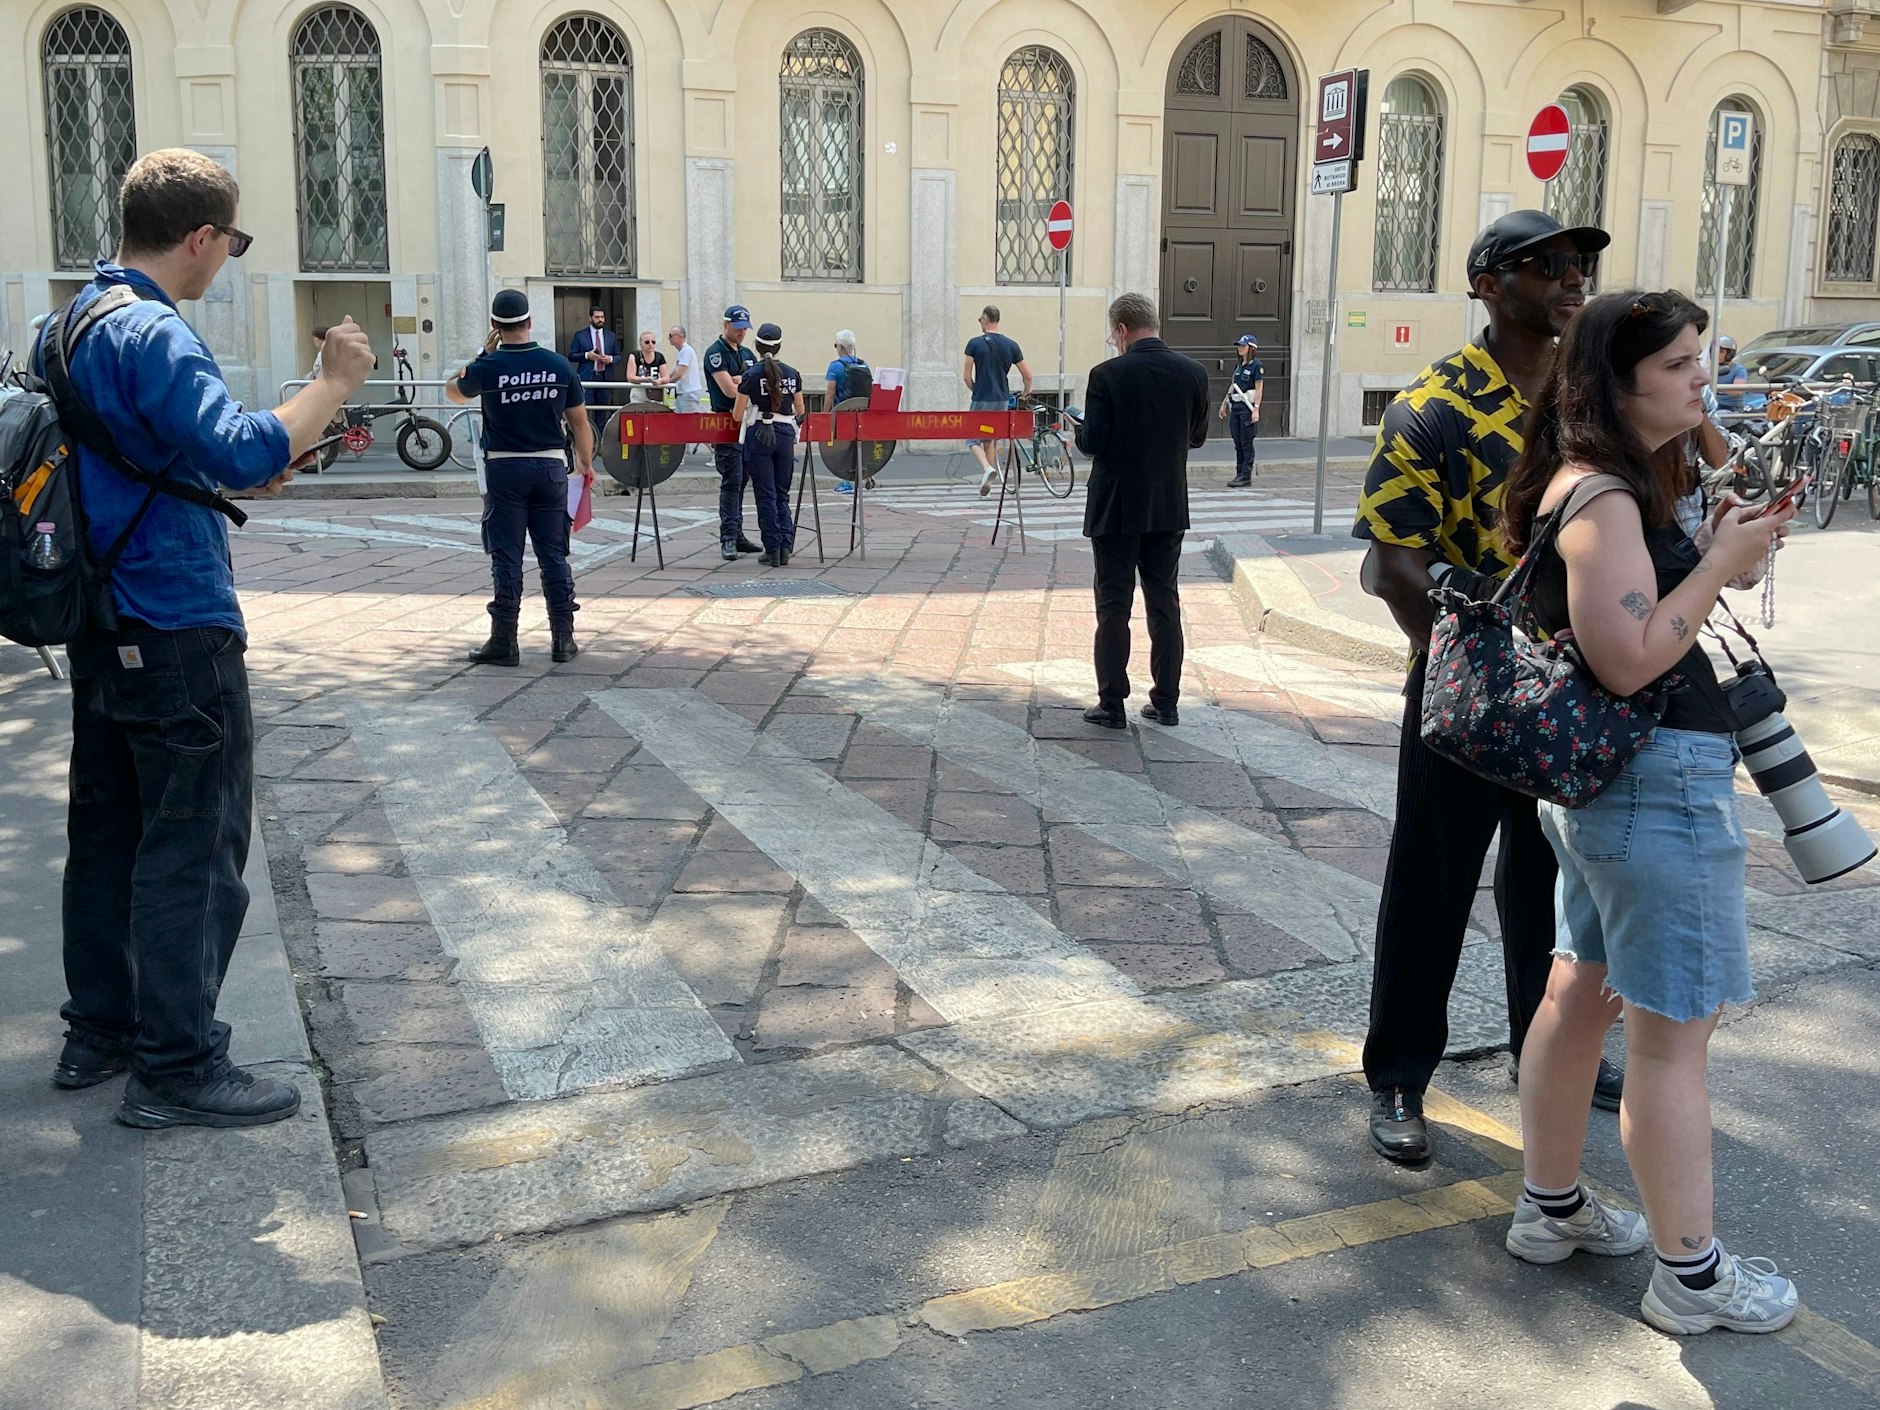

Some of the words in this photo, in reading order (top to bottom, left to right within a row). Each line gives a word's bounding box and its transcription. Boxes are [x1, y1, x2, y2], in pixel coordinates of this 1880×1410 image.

[1727, 120, 1742, 145] P
[498, 371, 557, 388] Polizia
[501, 387, 558, 404] Locale
[700, 416, 741, 431] ITALFL
